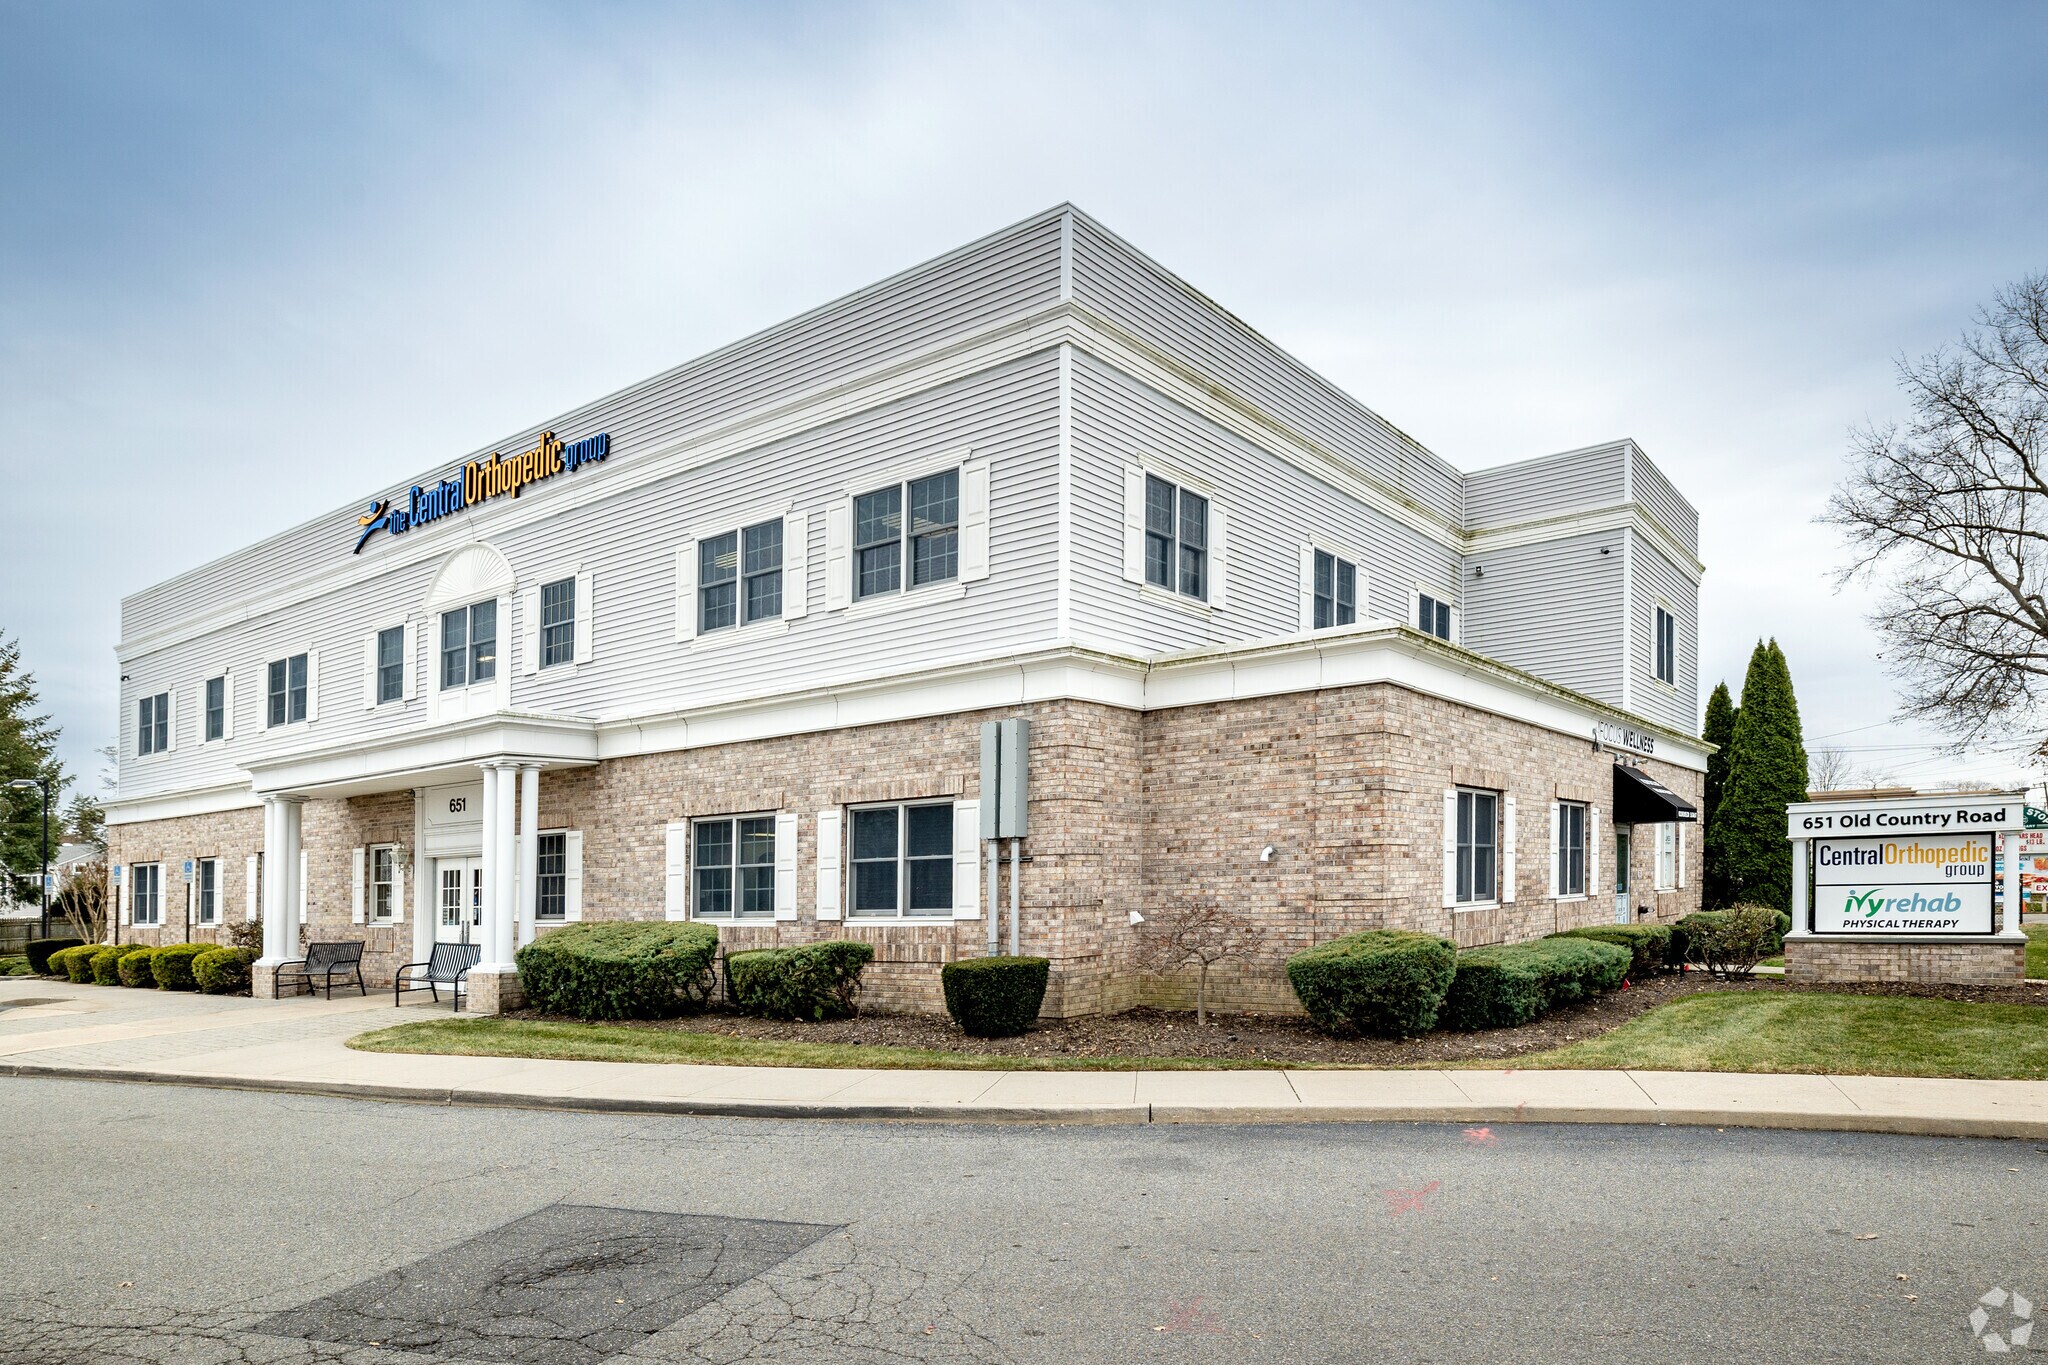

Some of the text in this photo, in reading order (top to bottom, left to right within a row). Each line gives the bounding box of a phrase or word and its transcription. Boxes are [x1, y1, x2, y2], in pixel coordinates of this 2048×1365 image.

[389, 509, 407, 534] the
[565, 432, 609, 472] group
[1623, 729, 1654, 754] WELLNESS
[449, 797, 466, 813] 651
[1803, 807, 2006, 829] 651 Old Country Road
[1820, 840, 1988, 869] CentralOrthopedic
[1945, 864, 1985, 878] group
[1842, 919, 1960, 928] PHYSICAL THERAPY
